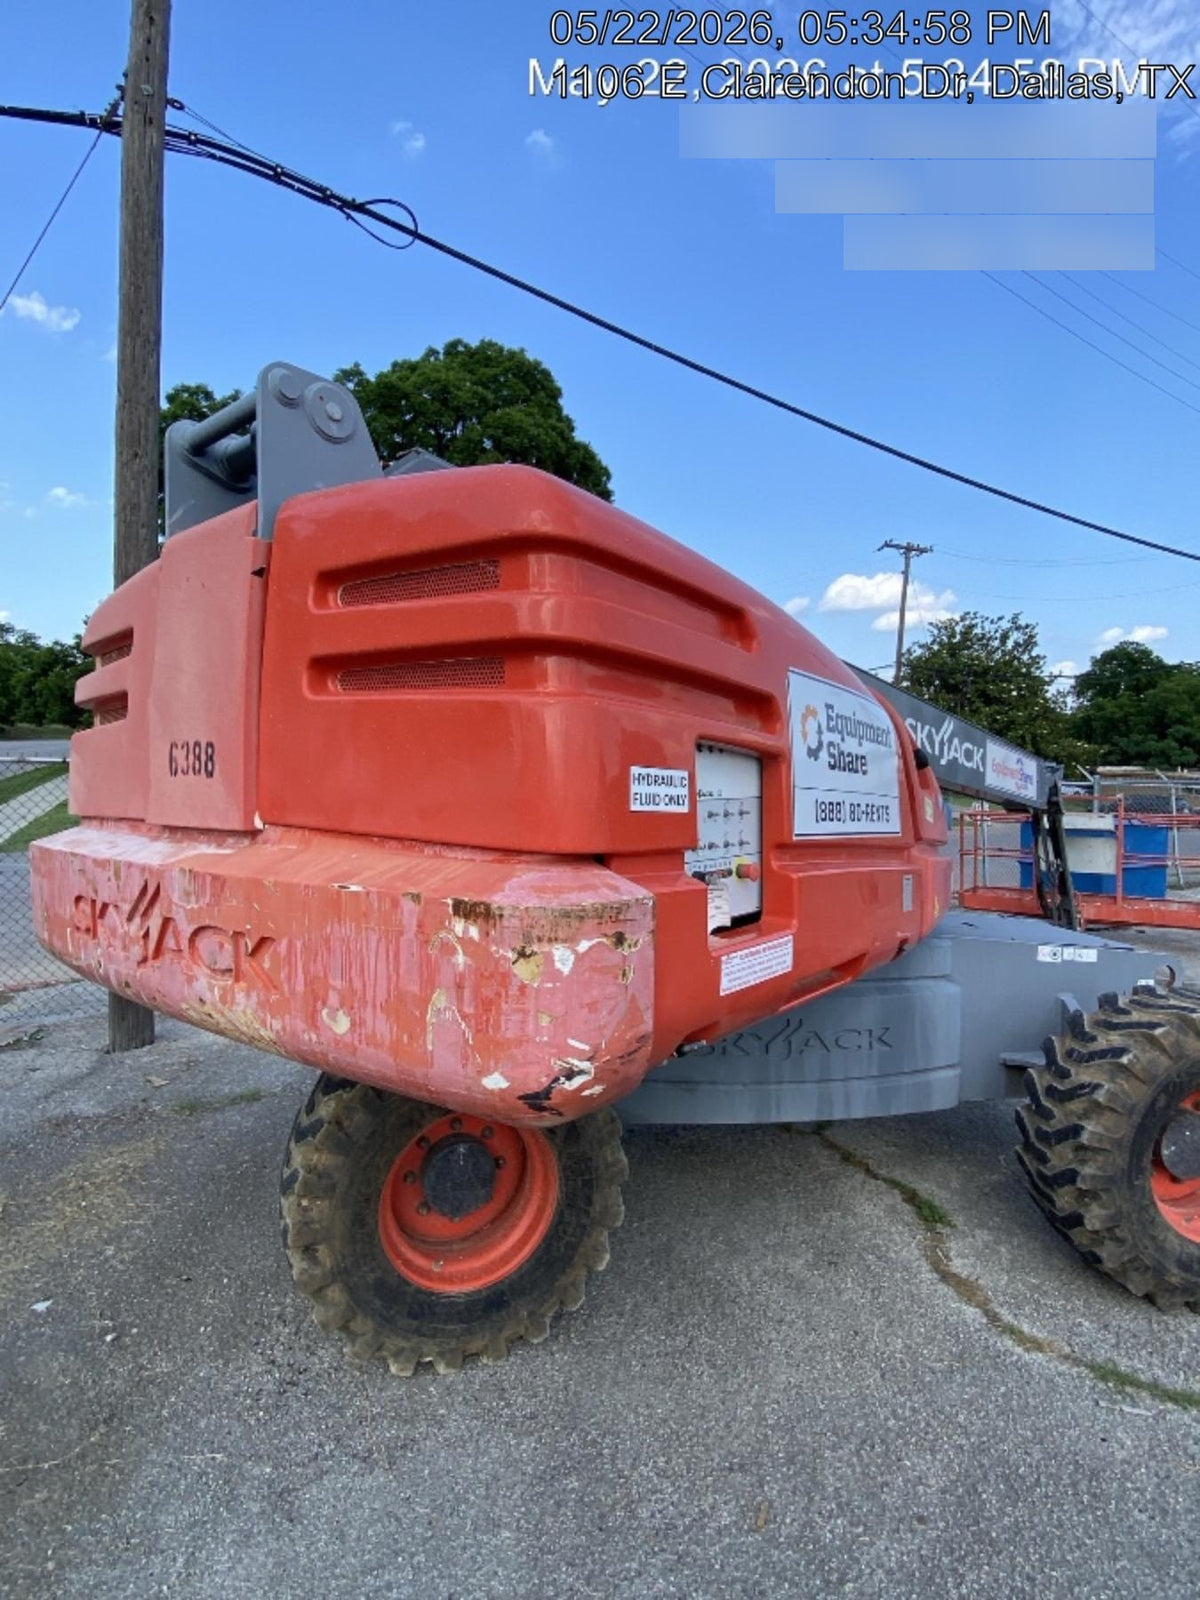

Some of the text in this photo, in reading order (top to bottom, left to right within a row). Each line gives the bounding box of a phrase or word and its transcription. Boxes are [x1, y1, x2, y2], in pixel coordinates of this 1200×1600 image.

[824, 701, 892, 749] Equipment
[168, 740, 216, 779] 6388
[826, 741, 869, 776] Share
[904, 715, 984, 772] SKYJACK
[632, 772, 688, 788] HYDRAULIC
[633, 791, 662, 807] FLUID
[662, 793, 687, 807] ONLY
[815, 798, 847, 824] (888)
